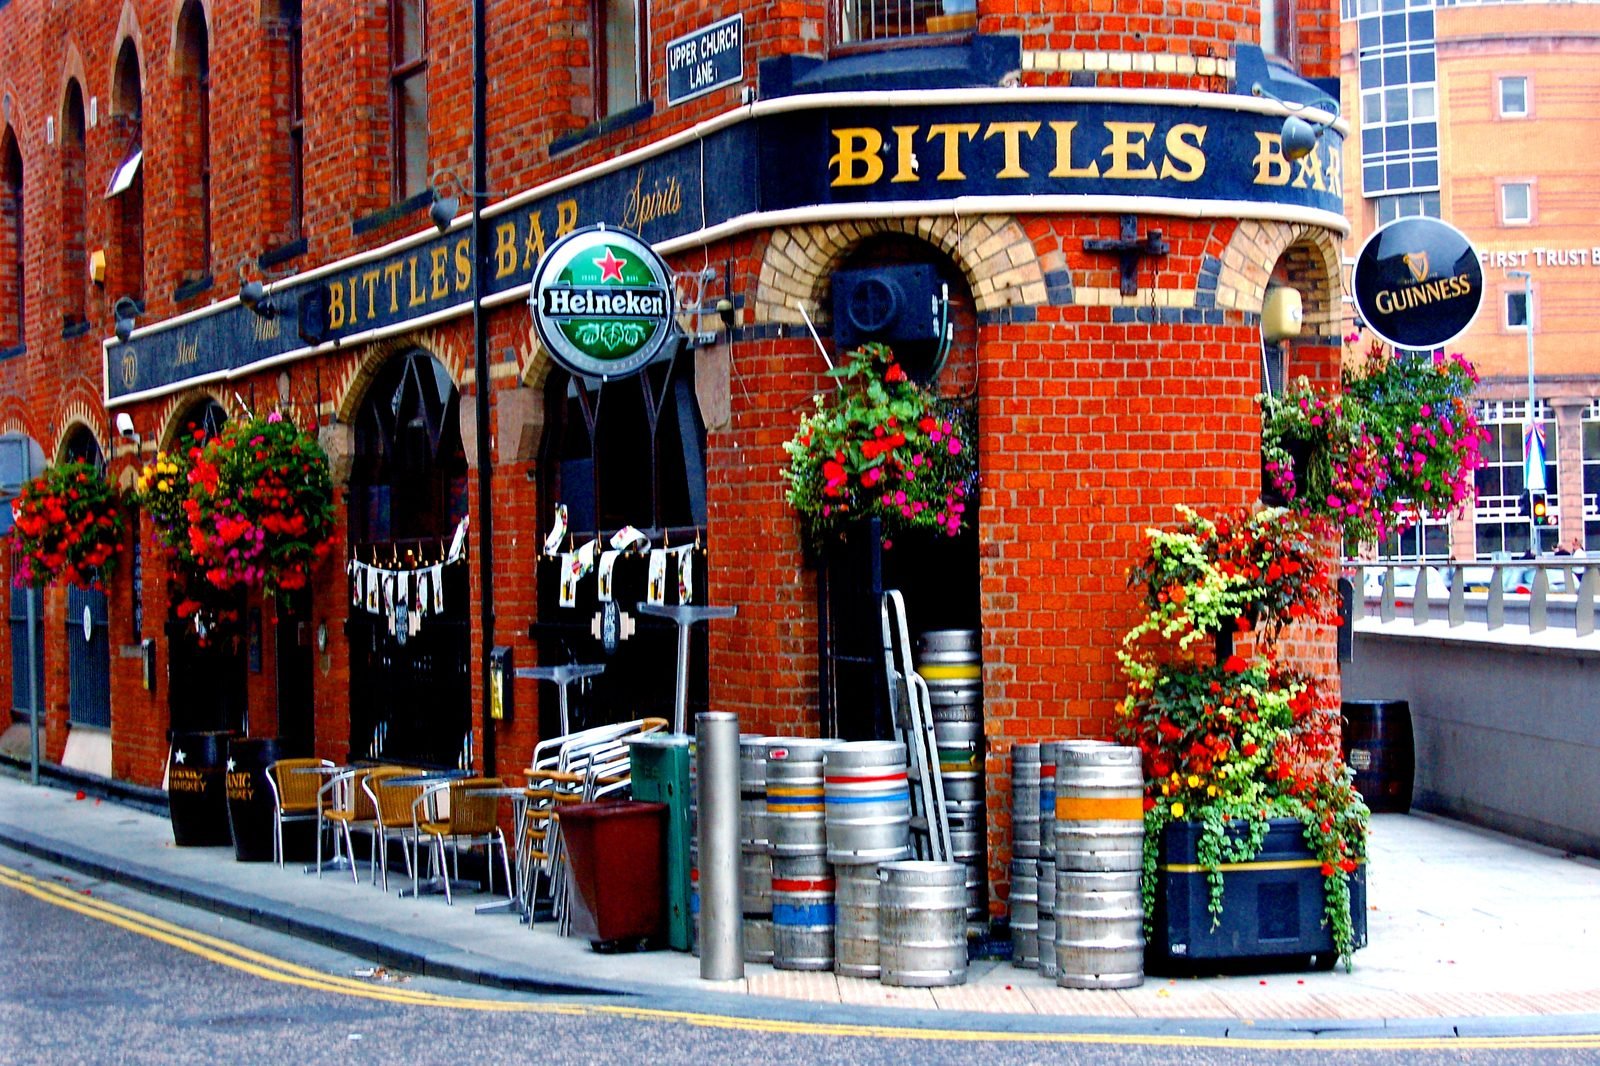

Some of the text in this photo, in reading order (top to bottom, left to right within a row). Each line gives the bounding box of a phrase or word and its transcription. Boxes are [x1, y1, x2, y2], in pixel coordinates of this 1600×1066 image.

[669, 23, 739, 71] UPPER CHURCH
[689, 59, 714, 90] LANE
[828, 120, 1343, 199] BITTLES BAR
[617, 167, 682, 238] Spirits
[328, 199, 577, 330] BITTLES BAR
[1481, 249, 1529, 268] FIRST
[1532, 247, 1588, 267] TRUST
[549, 289, 663, 315] Heineken
[1375, 273, 1471, 315] GUINNESS
